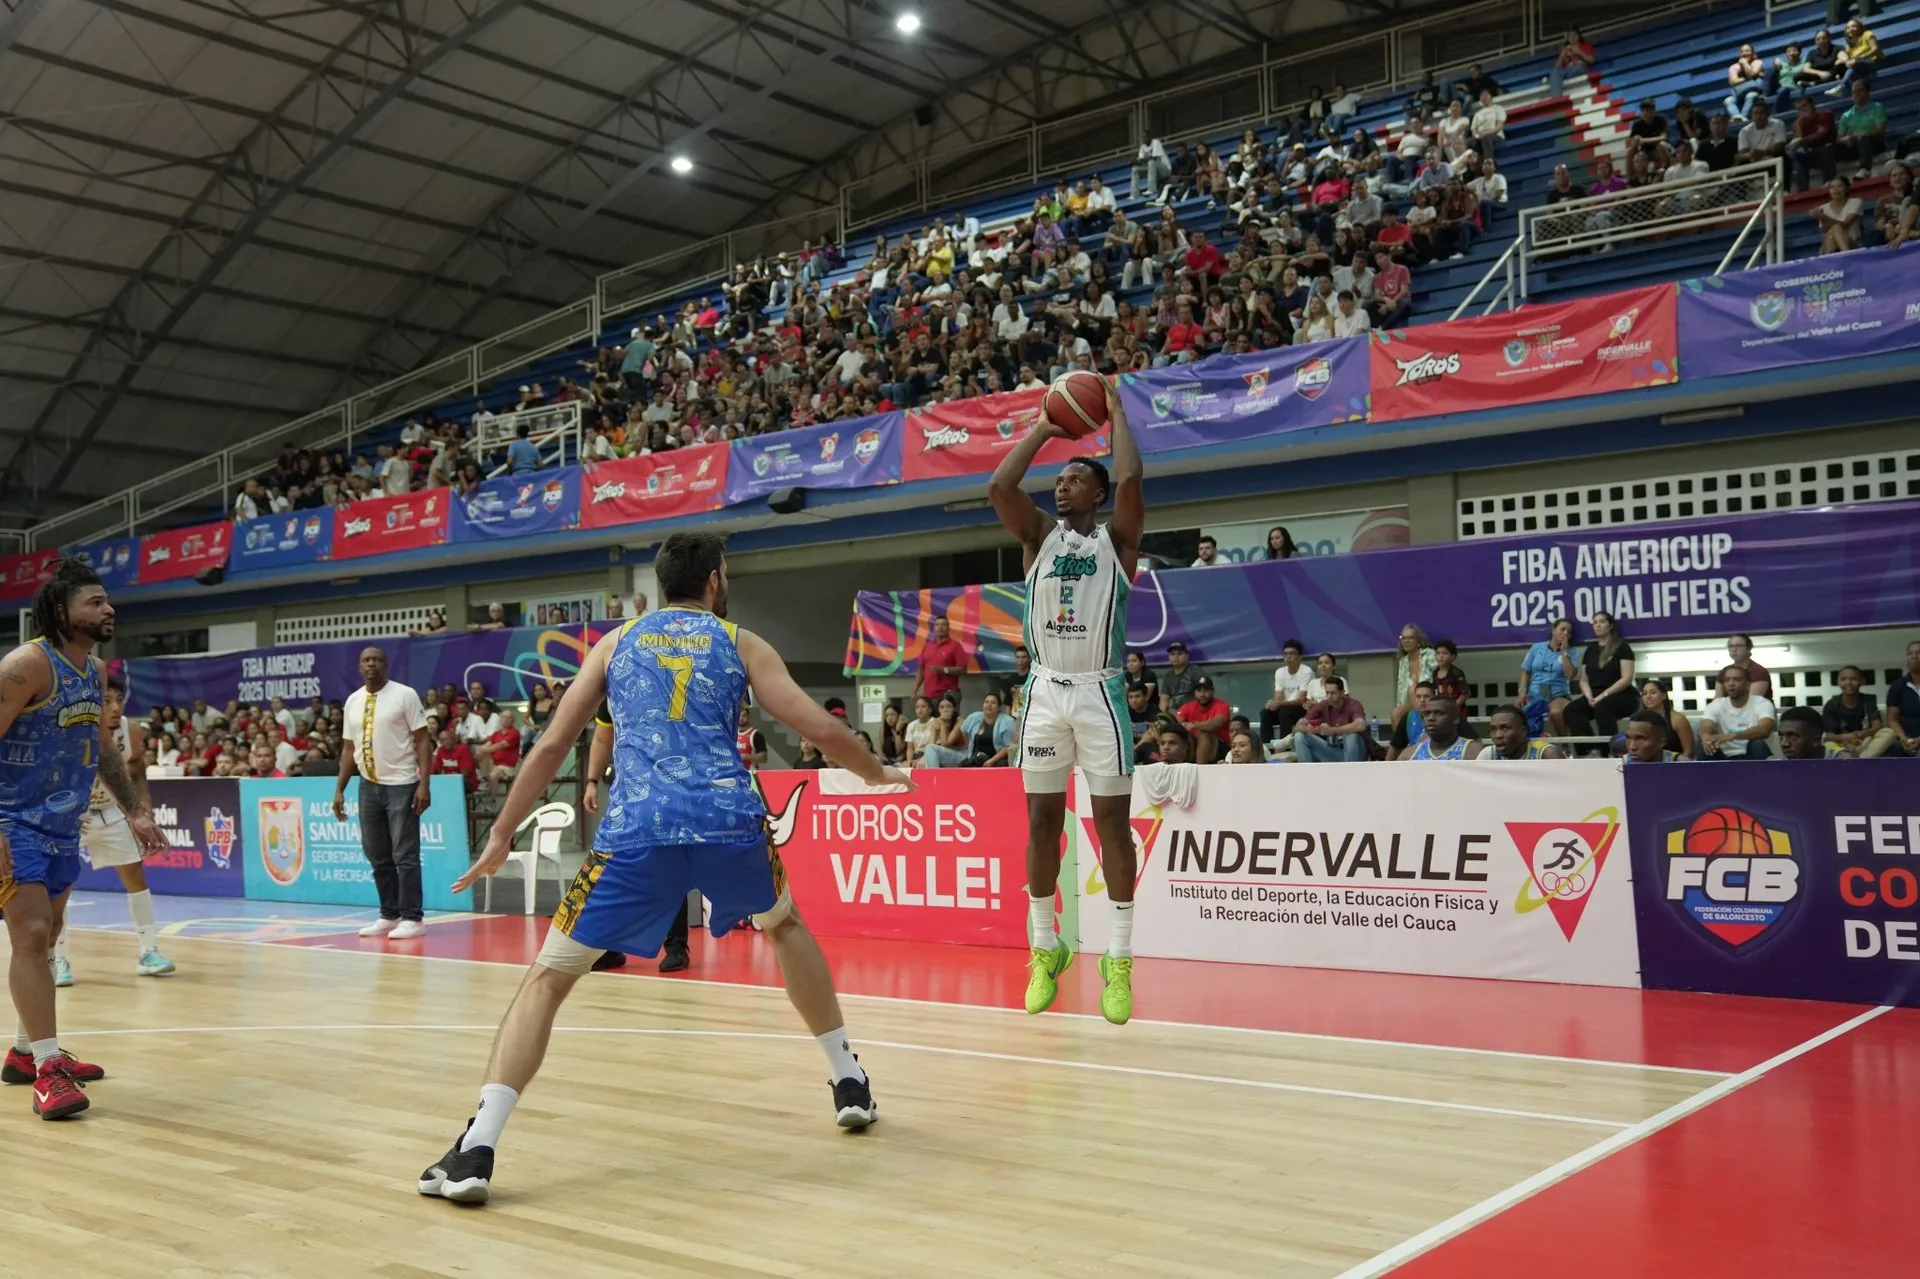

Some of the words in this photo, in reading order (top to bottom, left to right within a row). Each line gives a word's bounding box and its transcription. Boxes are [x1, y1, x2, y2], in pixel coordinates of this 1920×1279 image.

[1774, 269, 1844, 289] GOBERNACIÓN
[1835, 324, 1850, 333] del
[1851, 320, 1882, 330] Cauca
[1395, 352, 1461, 387] TOROS
[923, 425, 969, 452] TOROS
[1044, 553, 1097, 578] TROS
[1503, 546, 1567, 585] FIBA
[1575, 533, 1733, 580] AMERICUP
[1491, 589, 1566, 628] 2025
[1574, 576, 1752, 624] QUALIFIERS
[242, 658, 265, 679] FIBA
[265, 653, 315, 677] AMERICUP
[238, 681, 264, 702] 2025
[265, 677, 321, 701] QUALIFIERS
[657, 653, 694, 722] 7
[309, 798, 359, 816] ALCADÍA
[309, 822, 362, 842] SANTIA
[420, 823, 443, 842] ALI
[812, 803, 924, 842] ¡TOROS
[935, 803, 976, 843] ES
[207, 830, 231, 844] DPB
[1167, 830, 1492, 882] INDERVALLE
[333, 868, 375, 883] RECREAC
[829, 853, 1001, 910] VALLE!
[1667, 856, 1800, 903] FCB
[1839, 866, 1919, 908] CO
[1170, 884, 1227, 901] Instituto
[1232, 886, 1253, 902] del
[1257, 888, 1322, 907] Deporte,
[1327, 890, 1341, 905] la
[1345, 890, 1430, 909] Educación
[1435, 892, 1485, 911] Física
[1488, 898, 1499, 915] y
[1694, 905, 1732, 913] FEDERACIÓN
[1732, 907, 1773, 915] COLOMBIANA
[1200, 905, 1213, 919] la
[1216, 906, 1300, 924] Recreación
[1304, 909, 1327, 926] del
[1331, 911, 1369, 928] Valle
[1374, 912, 1398, 929] del
[1403, 914, 1457, 932] Cauca
[1702, 912, 1714, 920] DE
[1714, 913, 1766, 921] BALONCESTO
